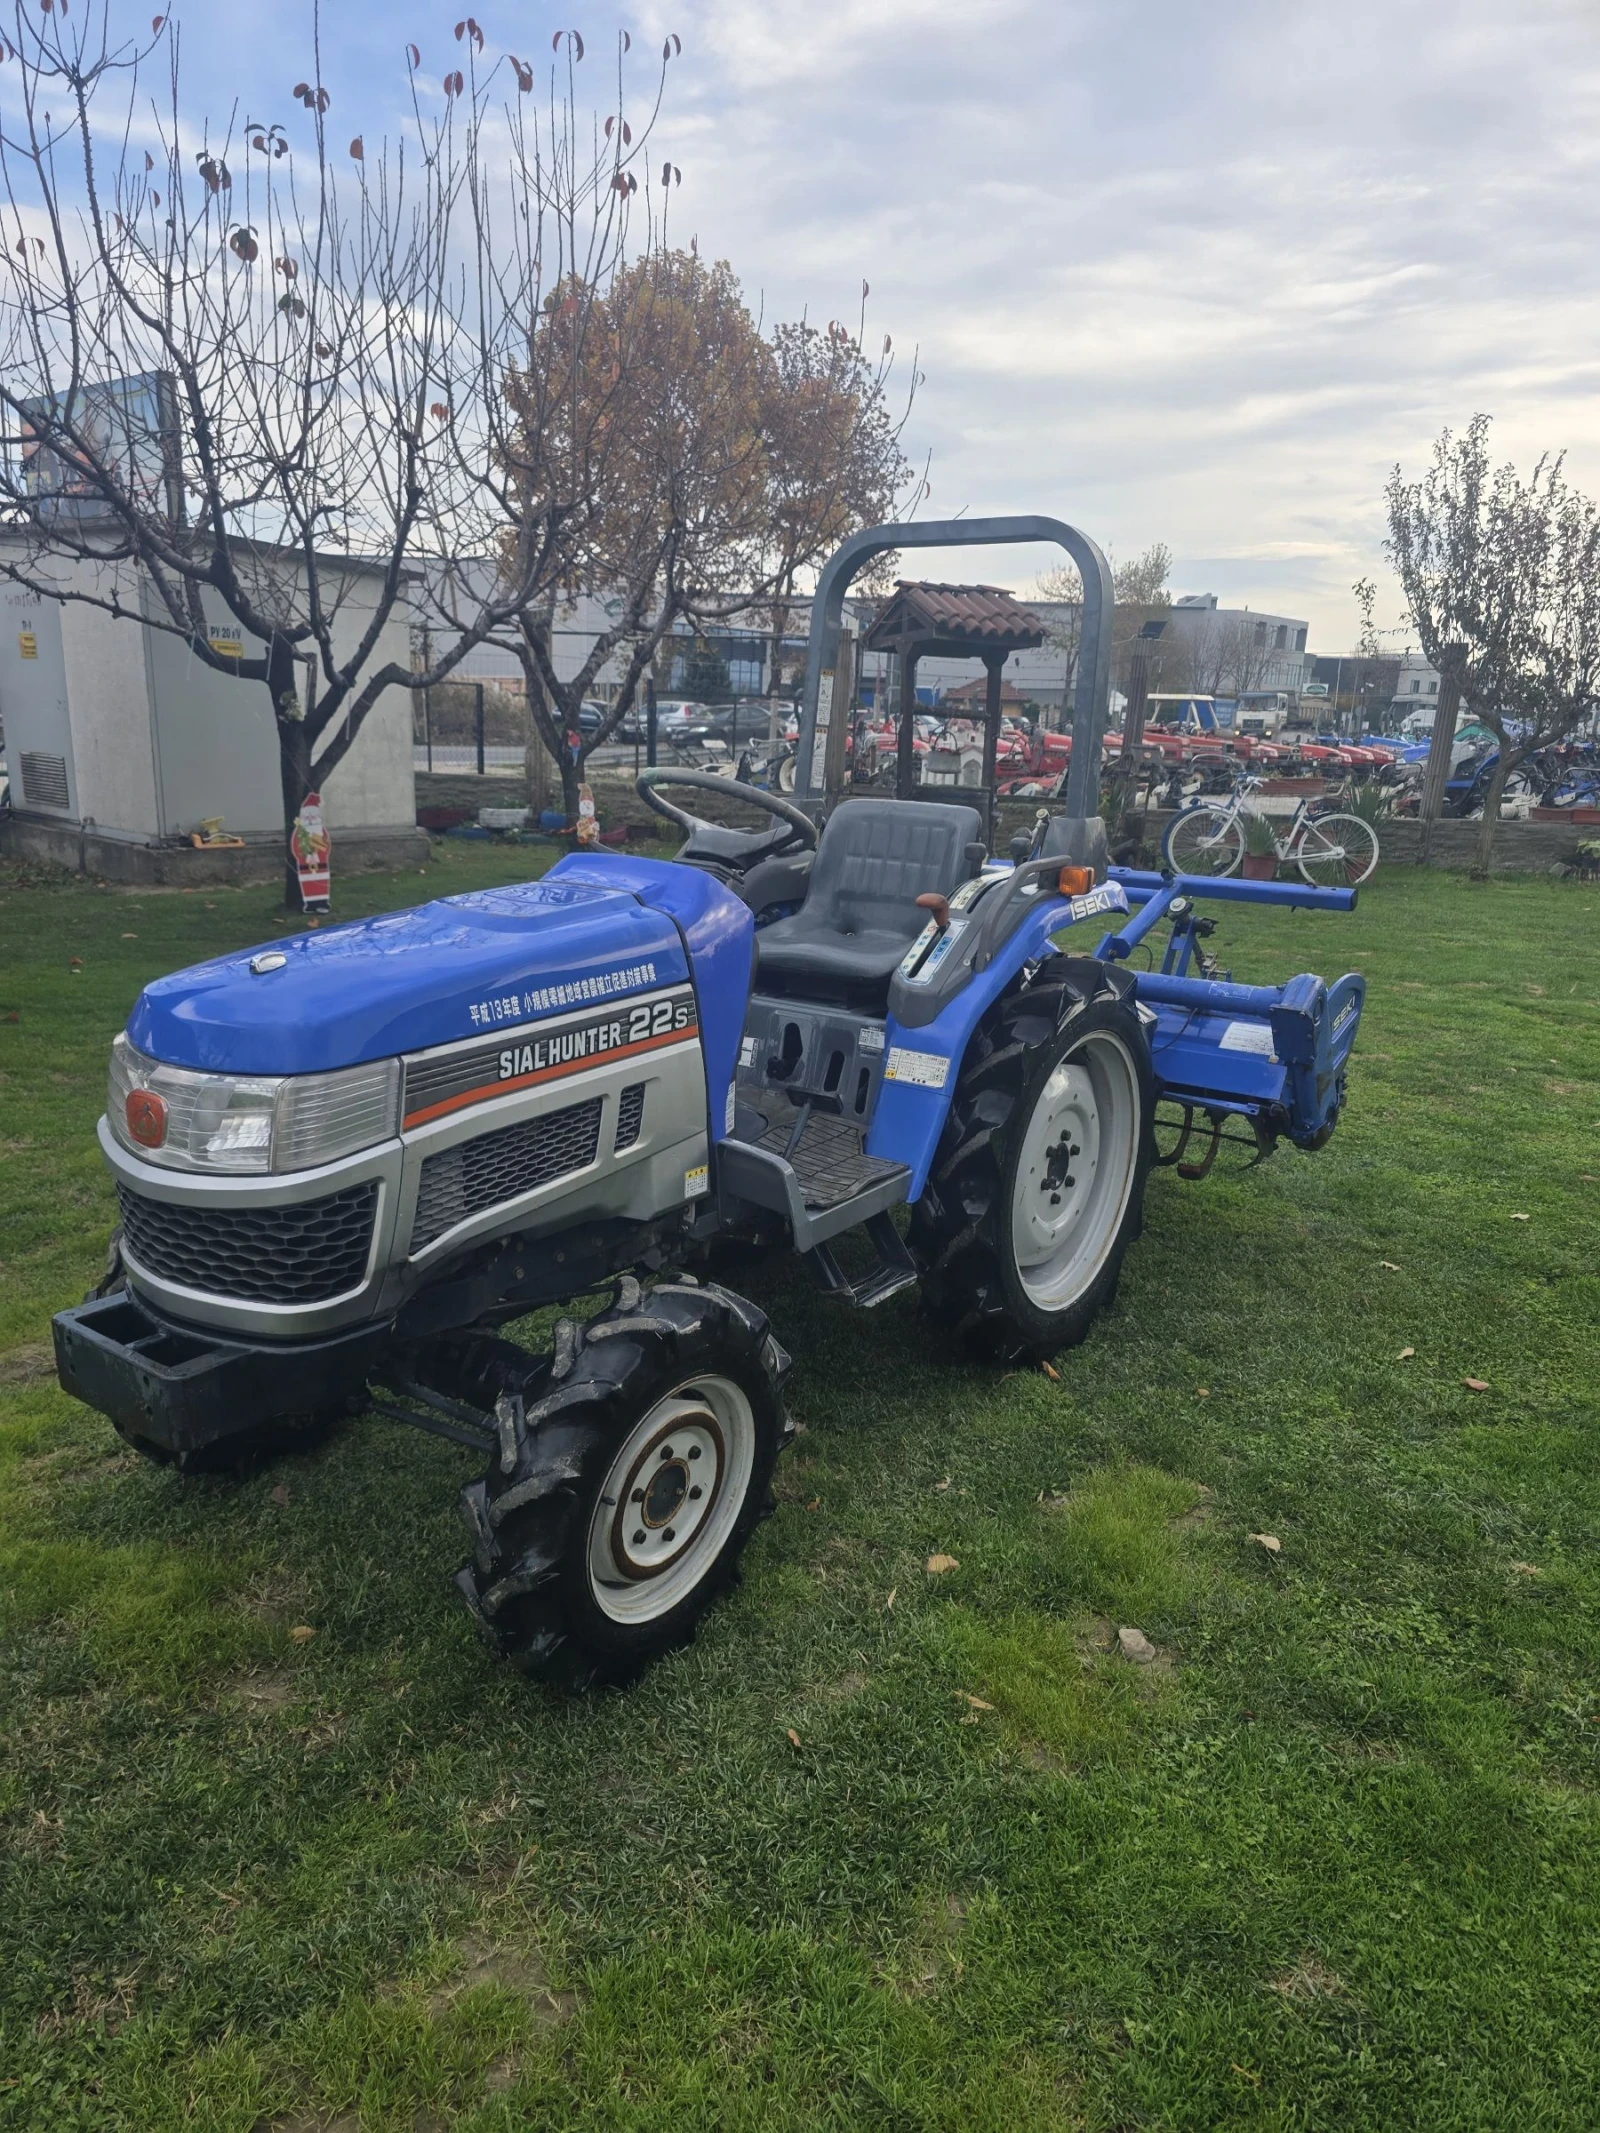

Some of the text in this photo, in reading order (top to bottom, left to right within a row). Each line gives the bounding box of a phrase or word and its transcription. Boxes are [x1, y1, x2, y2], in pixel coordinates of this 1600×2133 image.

[1070, 892, 1111, 920] ISEKI
[469, 995, 521, 1026] 平成13年度
[1331, 995, 1356, 1033] ISEKI
[499, 1042, 547, 1080] SIAL
[548, 1021, 622, 1066] HUNTER
